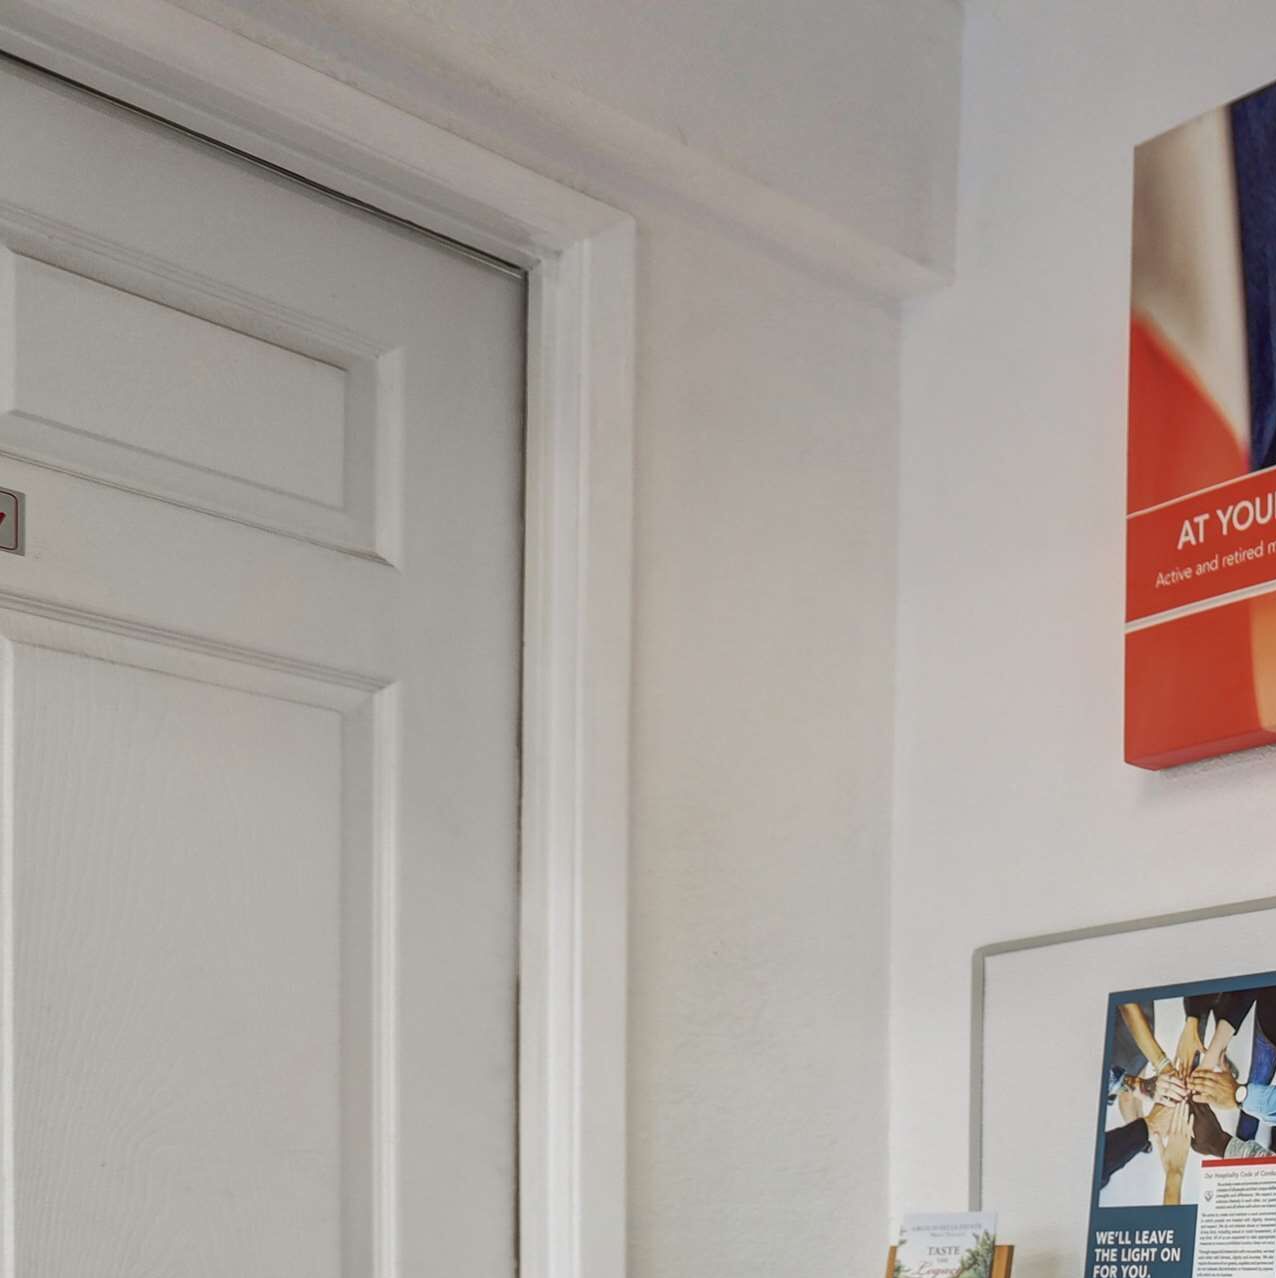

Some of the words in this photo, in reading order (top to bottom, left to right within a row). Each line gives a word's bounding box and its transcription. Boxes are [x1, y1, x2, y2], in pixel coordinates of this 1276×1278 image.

[1177, 513, 1210, 550] AT
[1155, 567, 1192, 588] Active
[1195, 554, 1219, 576] and
[1222, 543, 1264, 569] retired
[1096, 1231, 1131, 1245] WE'LL
[1135, 1230, 1174, 1244] LEAVE
[928, 1247, 961, 1256] TASTE
[1094, 1249, 1118, 1262] THE
[1121, 1248, 1157, 1262] LIGHT
[1160, 1248, 1180, 1262] ON
[1092, 1265, 1118, 1278] FOR
[1121, 1265, 1151, 1278] YOU.
